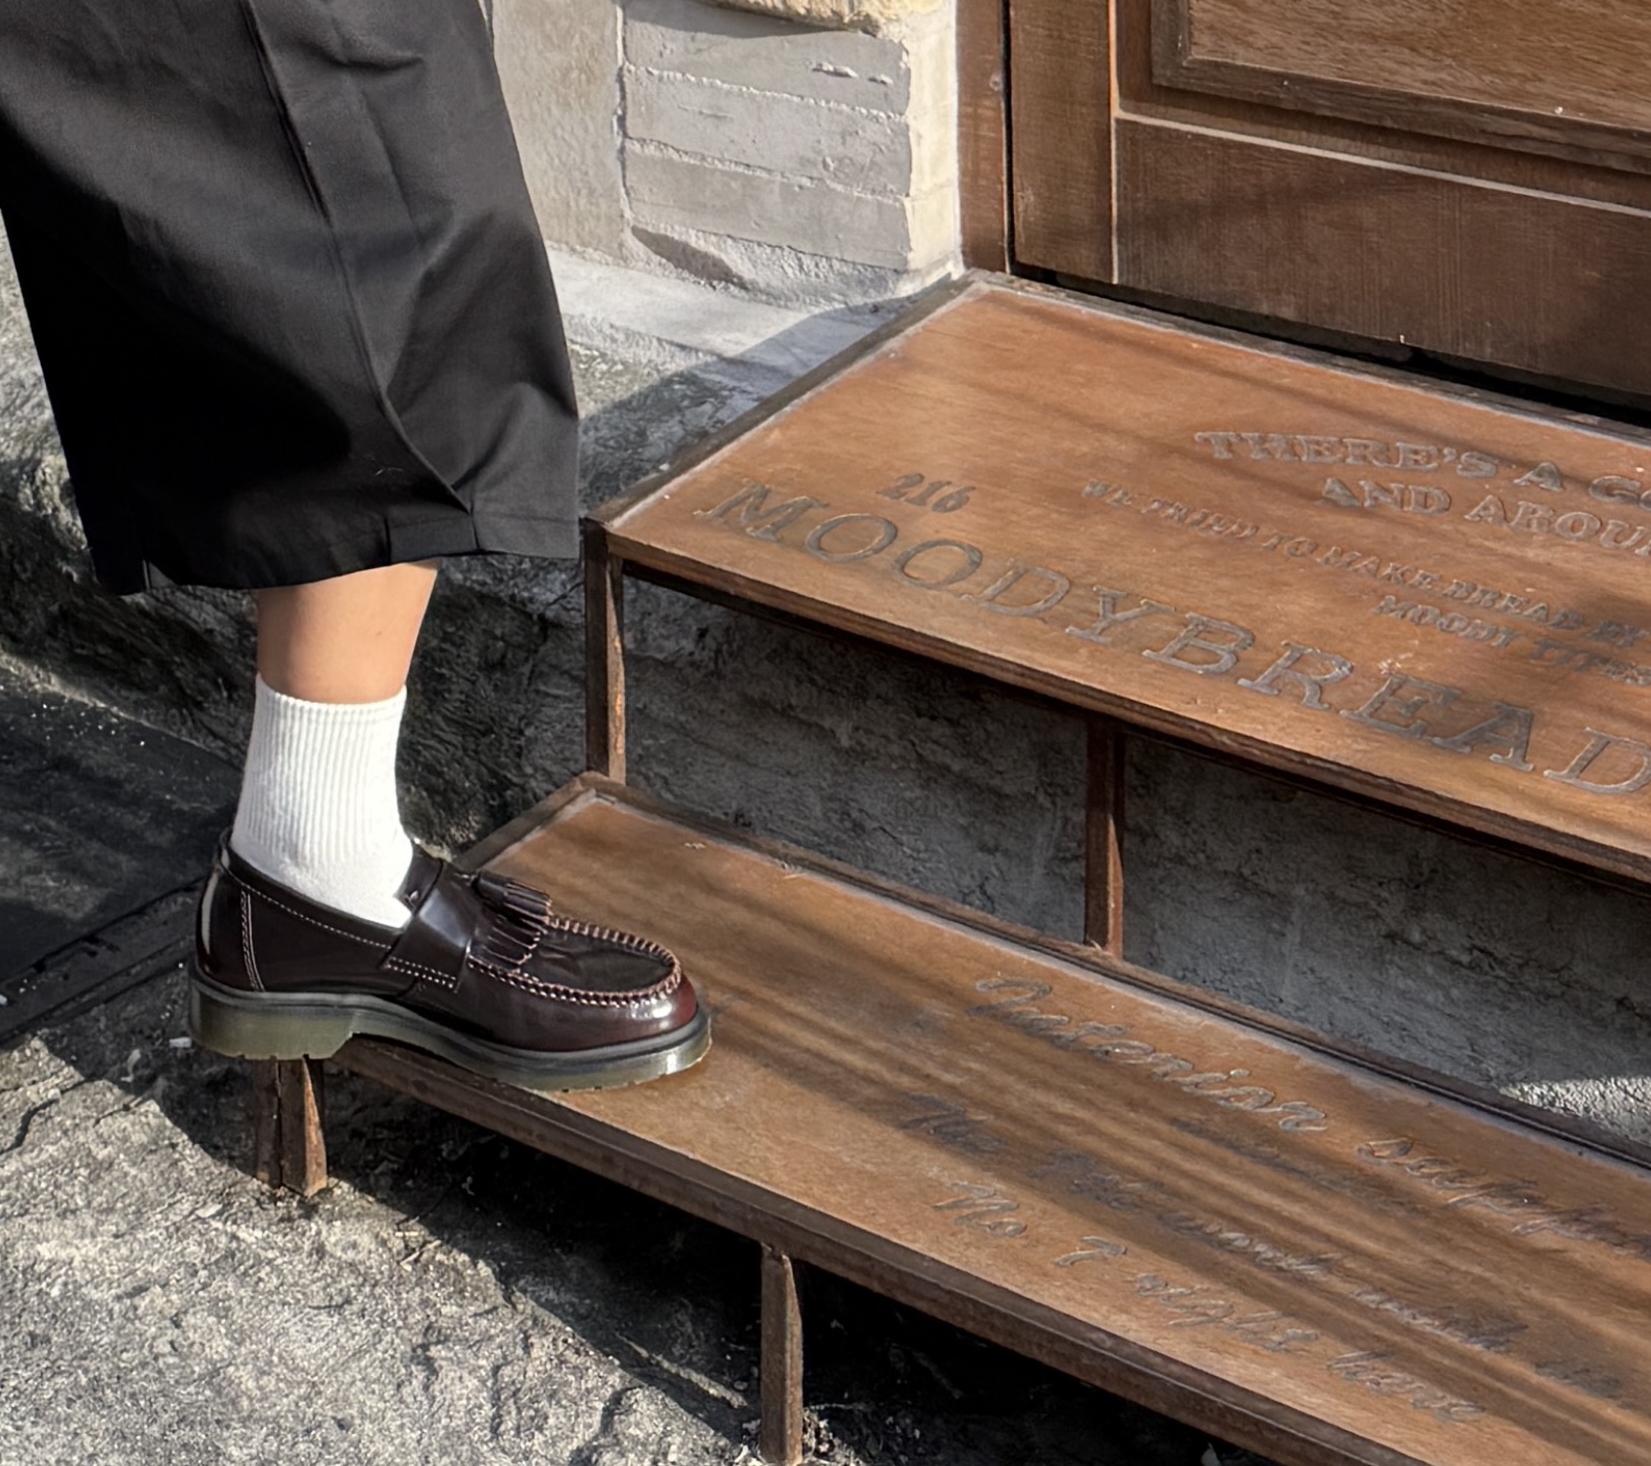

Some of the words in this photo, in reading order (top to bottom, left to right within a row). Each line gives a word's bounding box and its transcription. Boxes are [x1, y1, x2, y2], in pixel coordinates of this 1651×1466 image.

[1195, 431, 1499, 478] THERE'S
[877, 472, 977, 514] 216
[1320, 478, 1451, 515] AND
